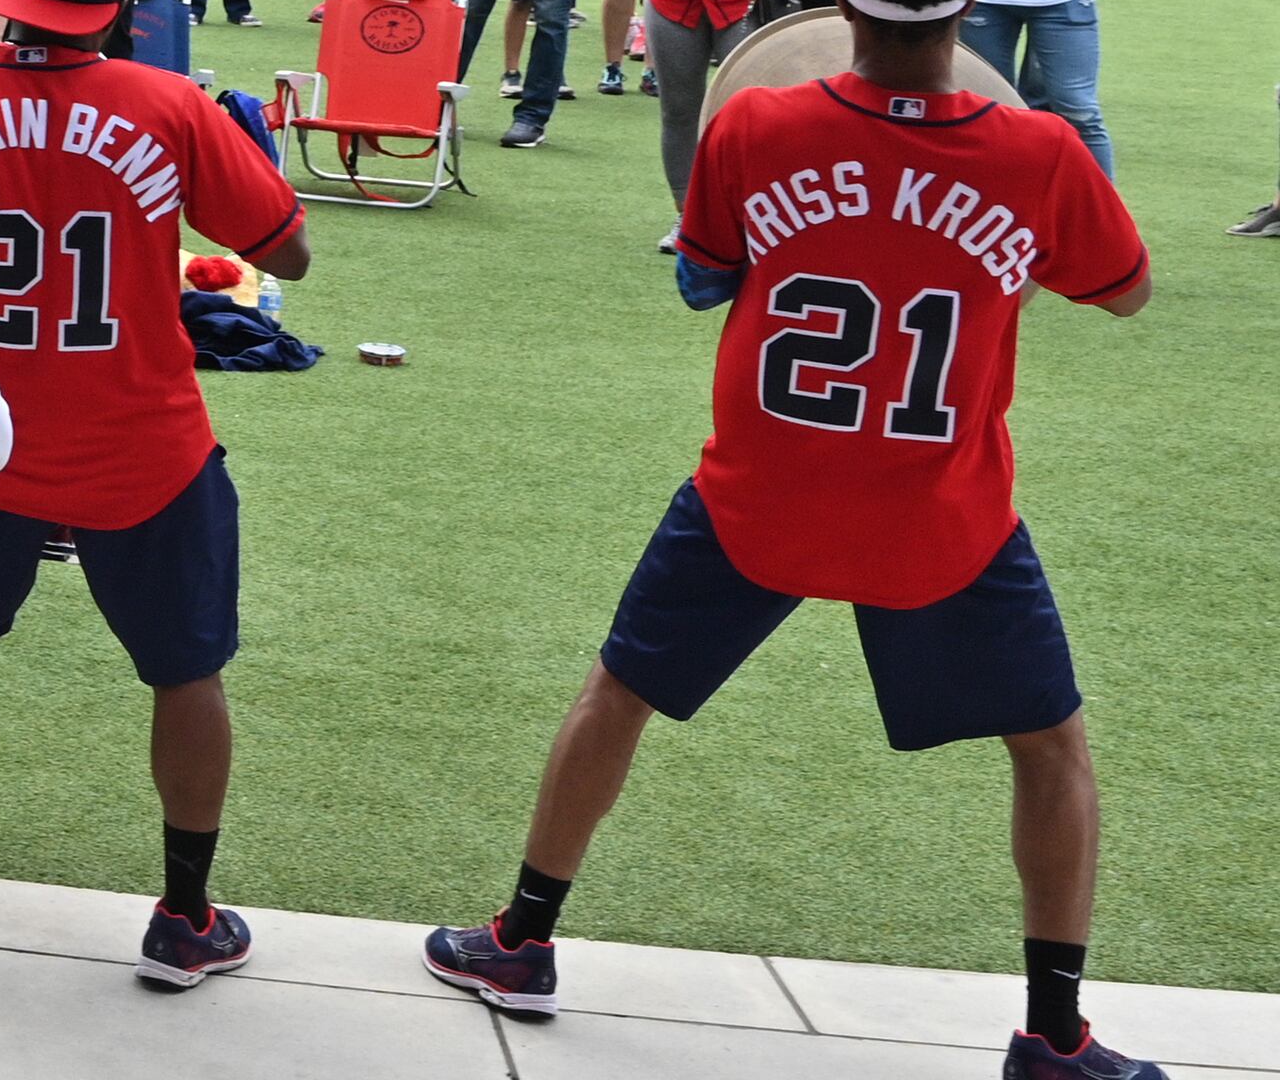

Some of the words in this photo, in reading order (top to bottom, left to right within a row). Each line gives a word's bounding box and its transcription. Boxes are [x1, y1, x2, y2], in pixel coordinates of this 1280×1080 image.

[372, 9, 415, 25] TOMMY
[62, 102, 187, 223] BENNY
[758, 272, 961, 443] 21
